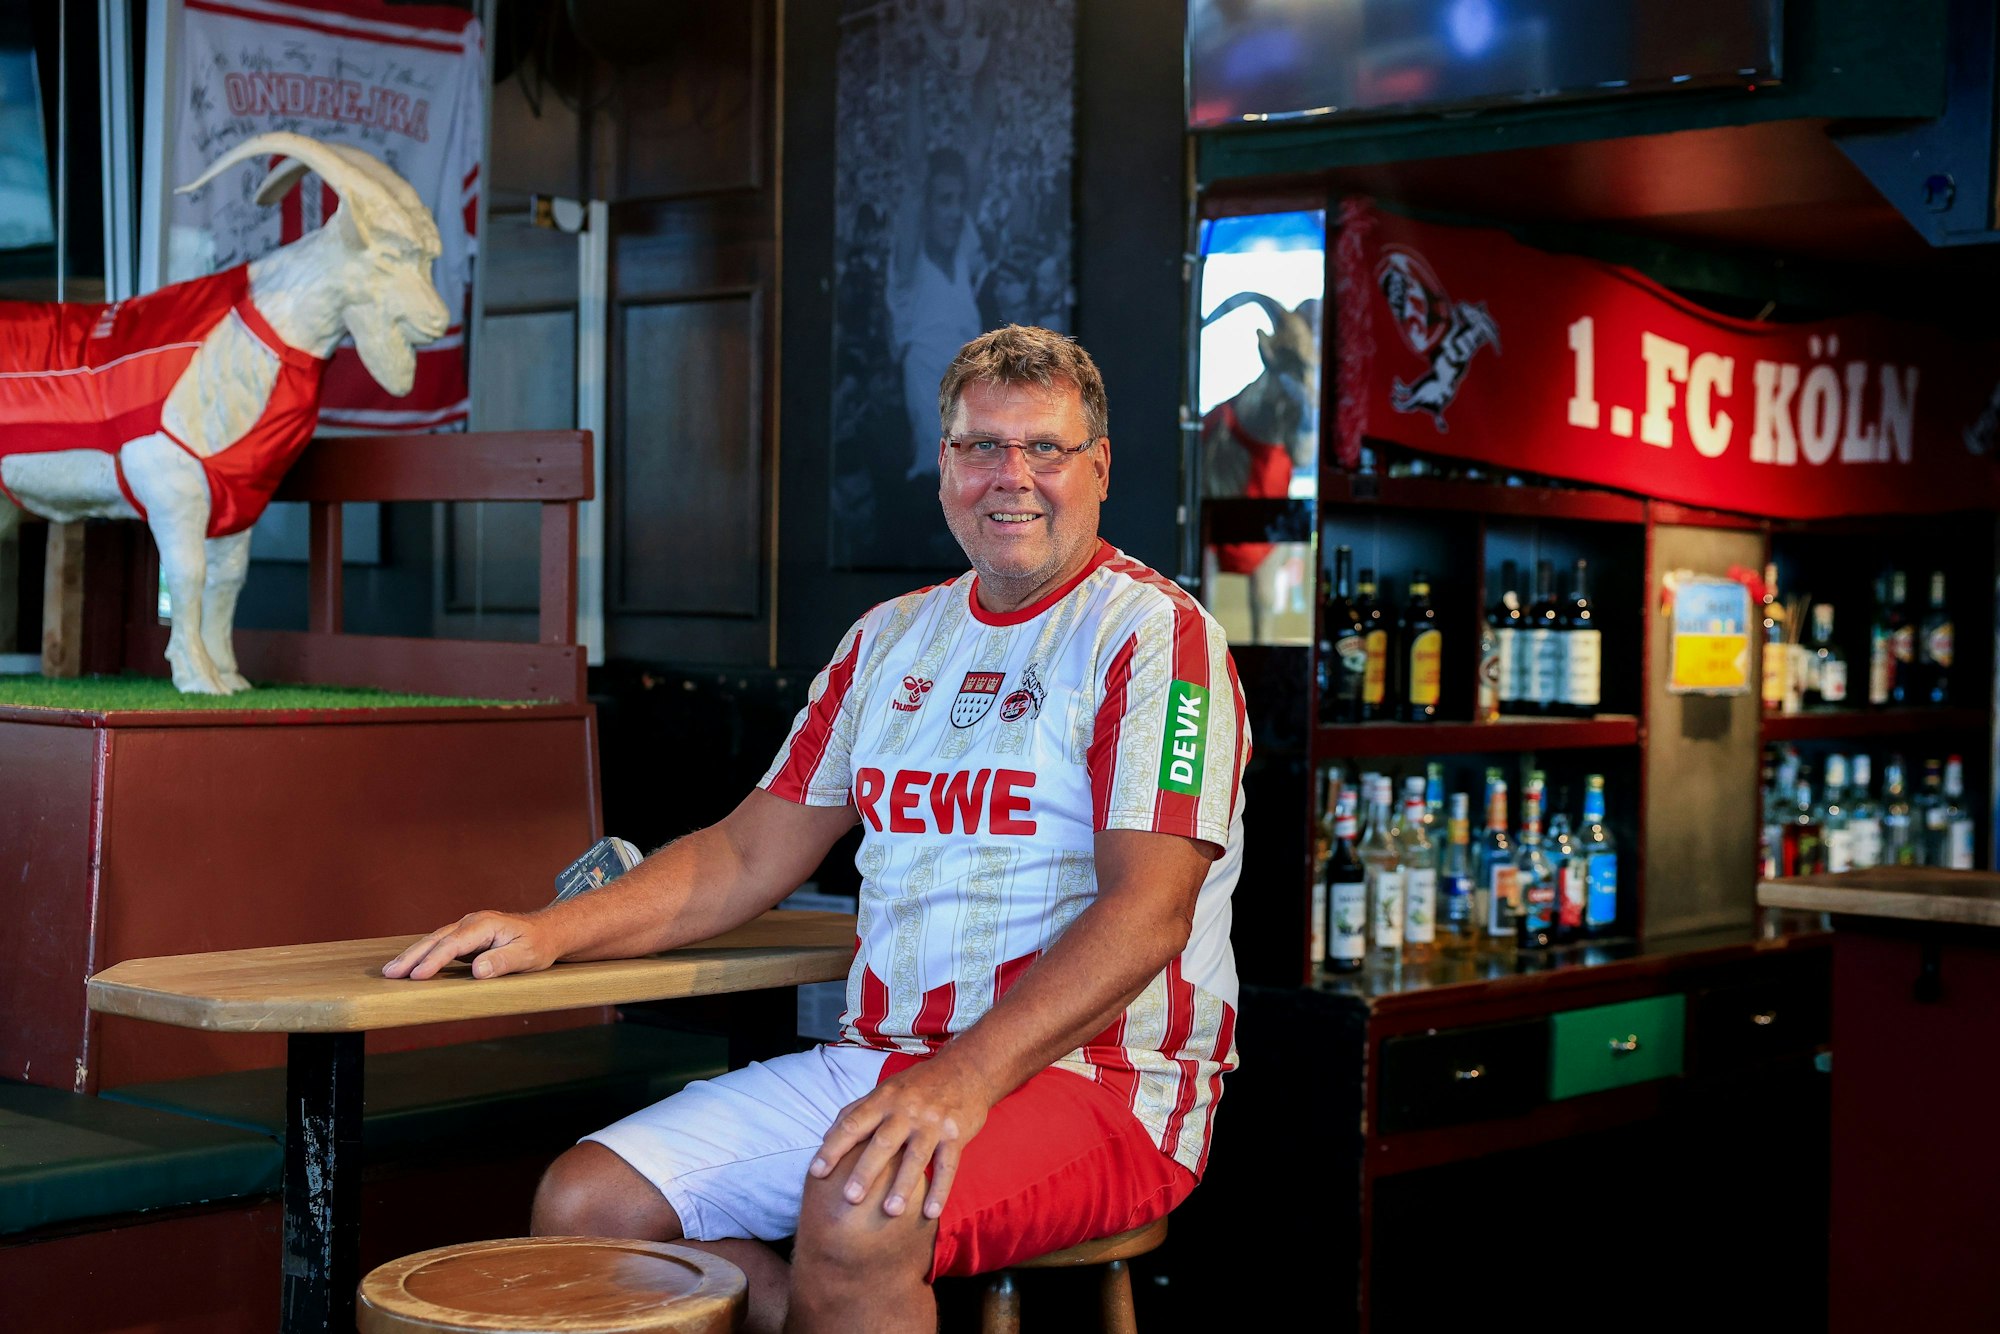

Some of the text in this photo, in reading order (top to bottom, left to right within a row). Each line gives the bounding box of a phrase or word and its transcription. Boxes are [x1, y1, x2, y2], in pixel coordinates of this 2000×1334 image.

[225, 72, 429, 143] ONDREJKA
[1750, 335, 1918, 465] KÖLN
[1169, 693, 1201, 786] DEVK
[856, 767, 1037, 835] REWE
